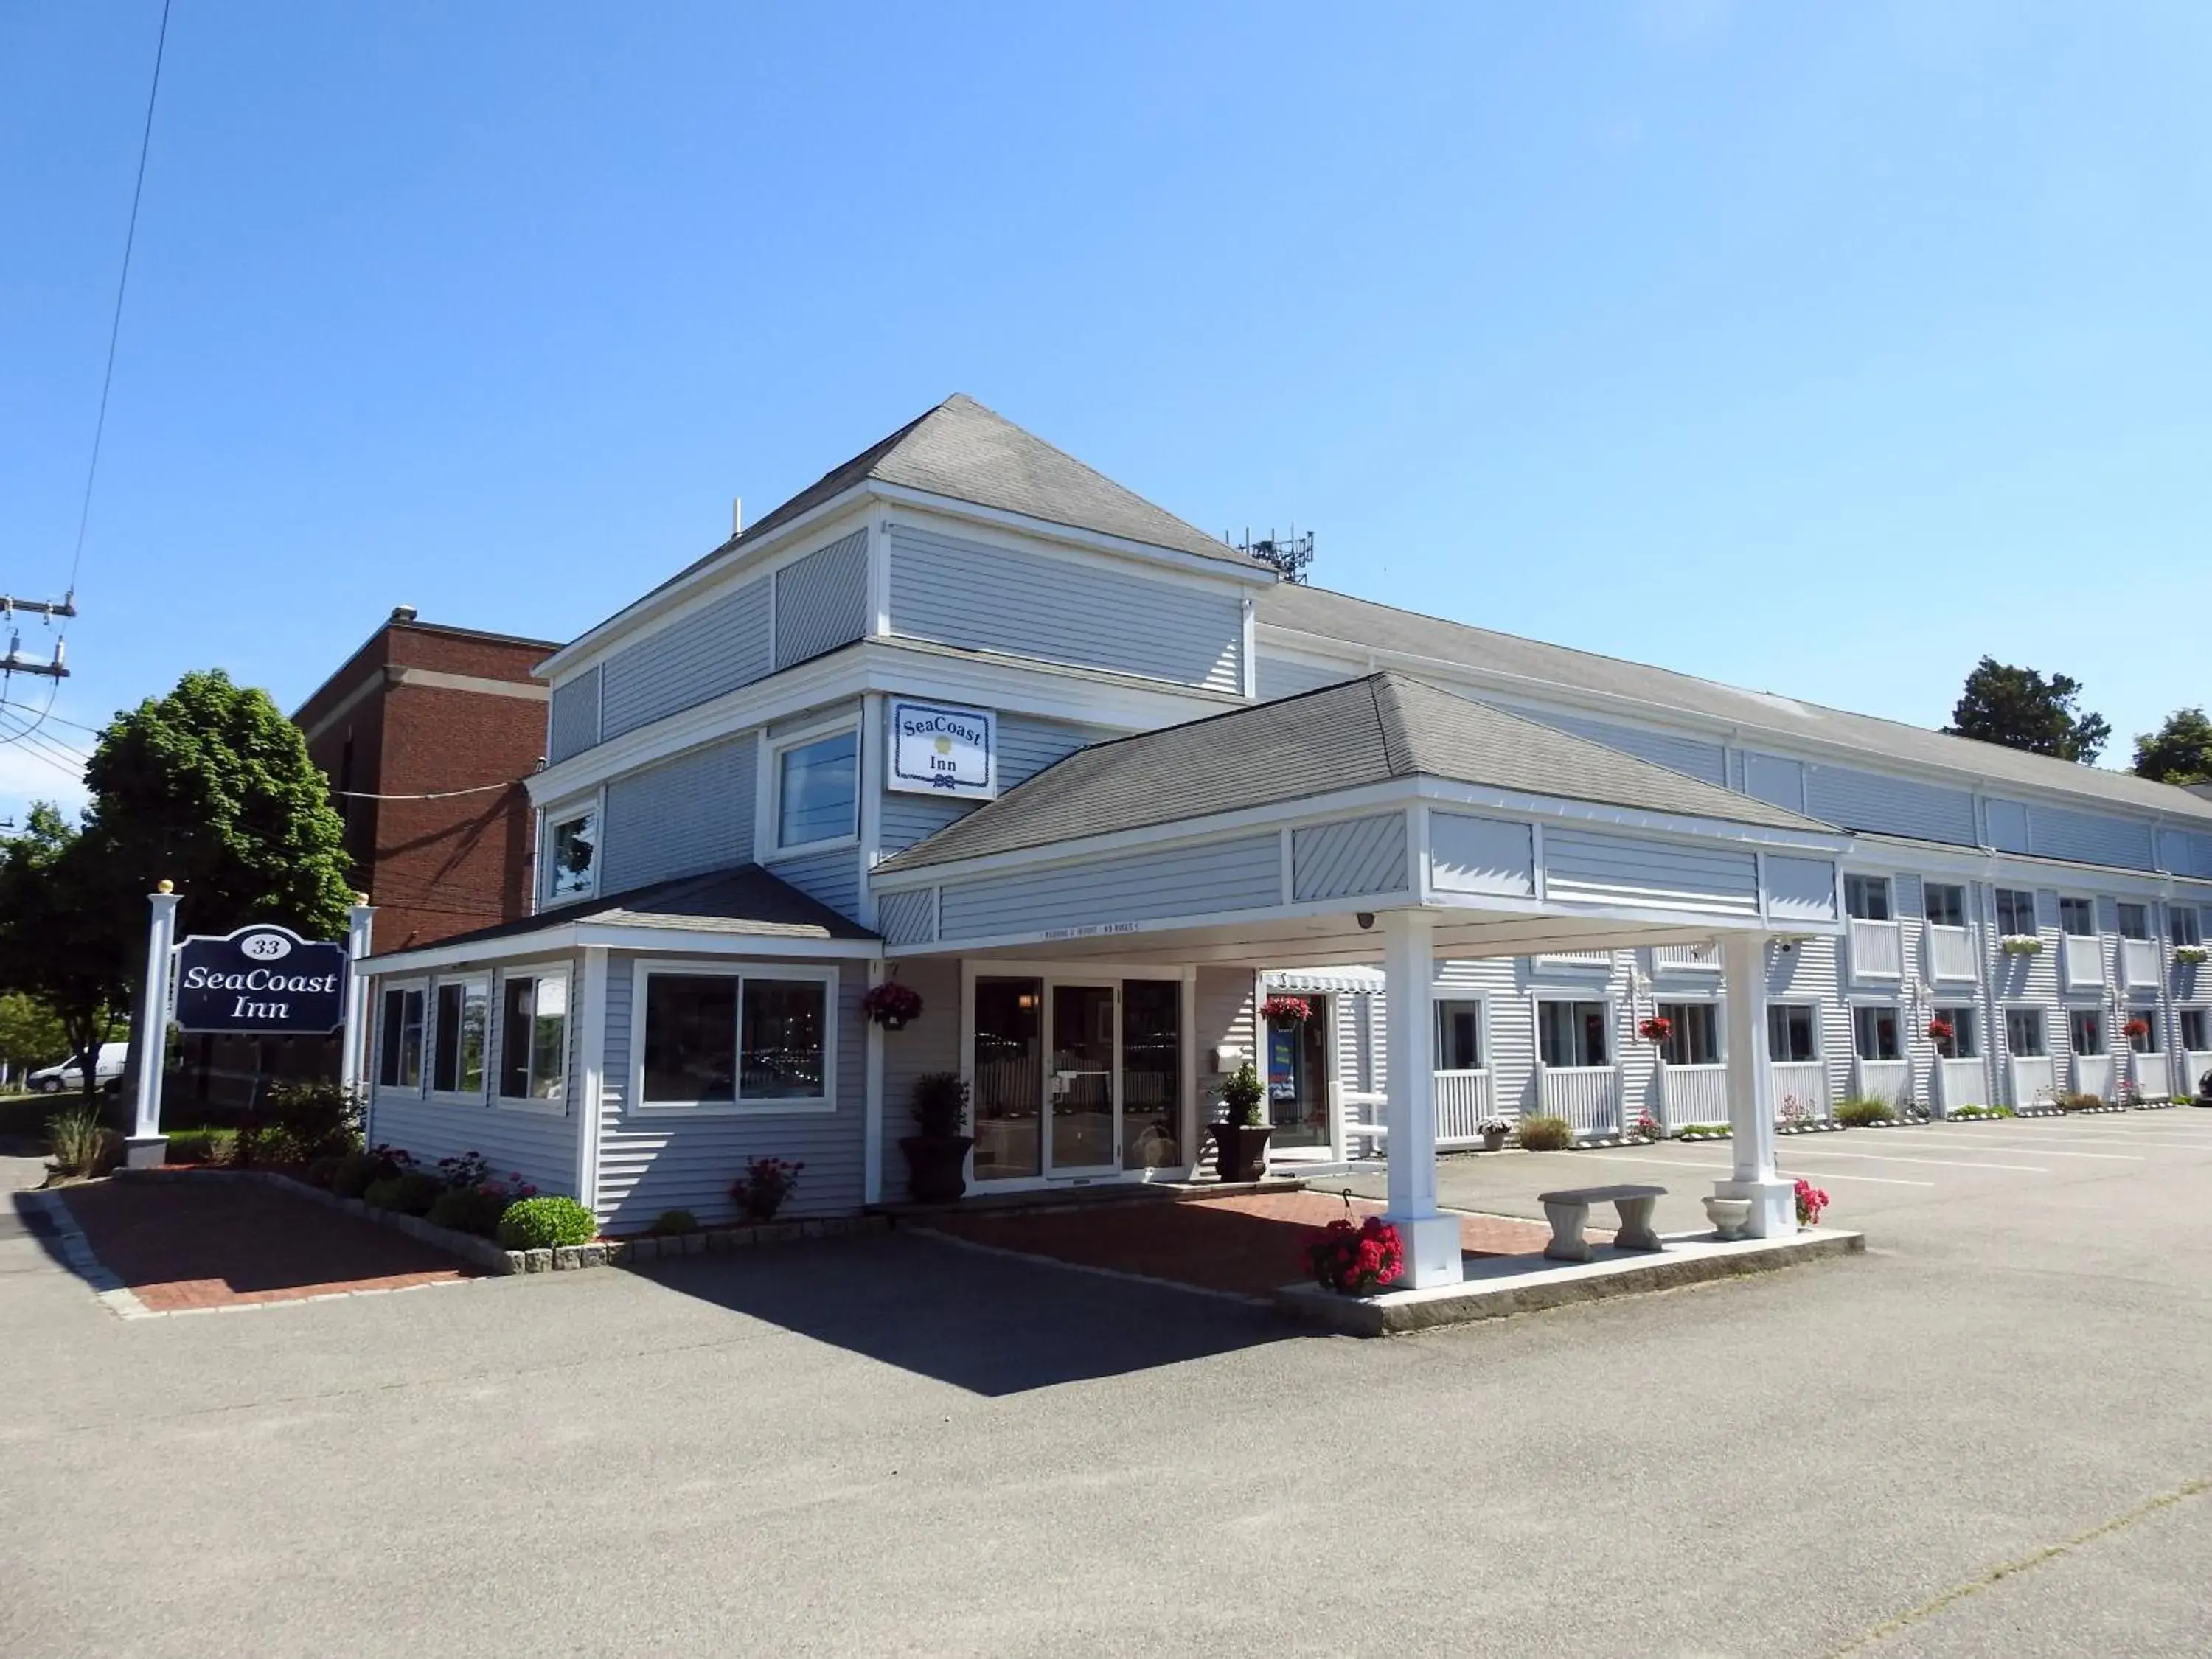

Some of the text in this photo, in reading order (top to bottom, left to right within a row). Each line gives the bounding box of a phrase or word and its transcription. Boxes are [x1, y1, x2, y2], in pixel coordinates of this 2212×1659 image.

[903, 716, 981, 745] SeaCoast
[930, 755, 956, 772] Inn
[252, 940, 279, 955] 33
[184, 967, 338, 992] SeaCoast
[230, 995, 290, 1018] Inn
